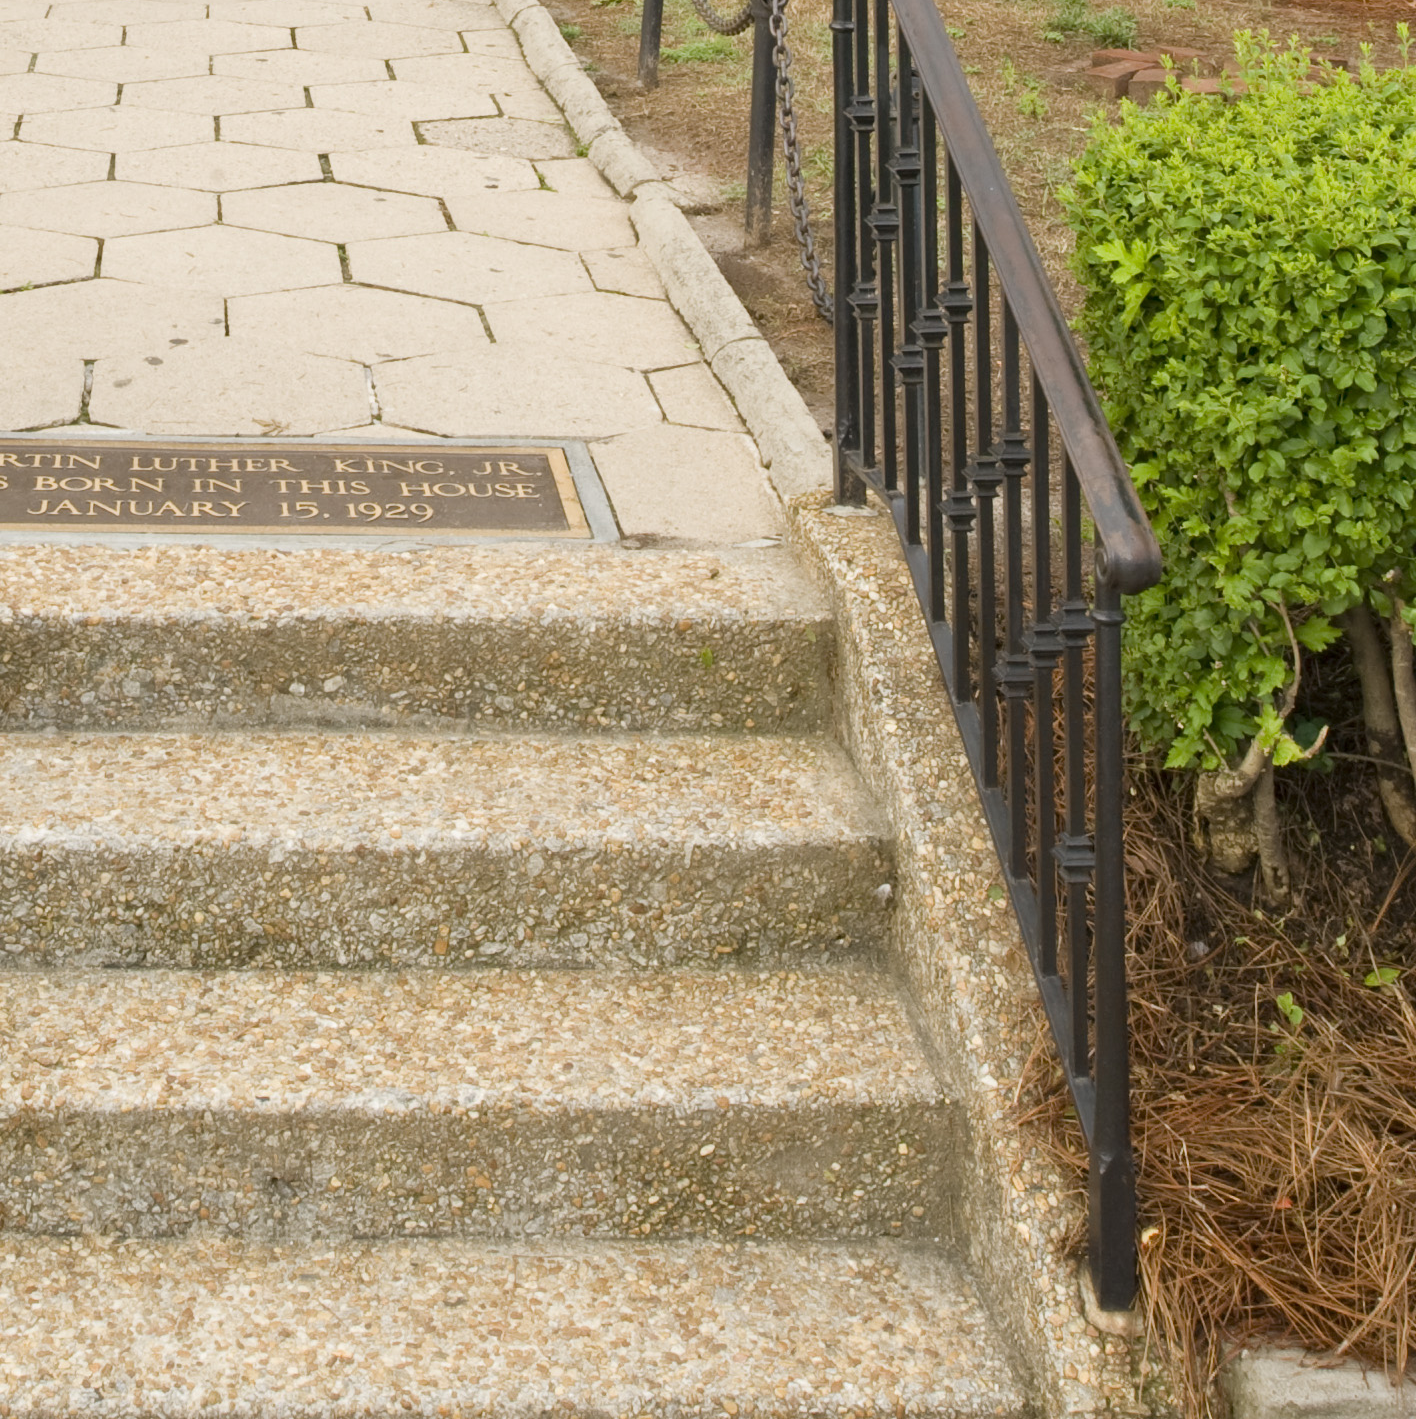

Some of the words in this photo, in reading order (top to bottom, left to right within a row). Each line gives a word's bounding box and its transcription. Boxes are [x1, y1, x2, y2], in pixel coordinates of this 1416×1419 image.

[129, 456, 304, 472] LUTHER
[472, 461, 543, 476] JR.
[32, 475, 166, 493] BORN
[191, 478, 243, 493] IN
[269, 479, 372, 495] THIS
[399, 481, 541, 498] HOUSE
[26, 499, 252, 517] JANUARY
[345, 502, 434, 523] 1929
